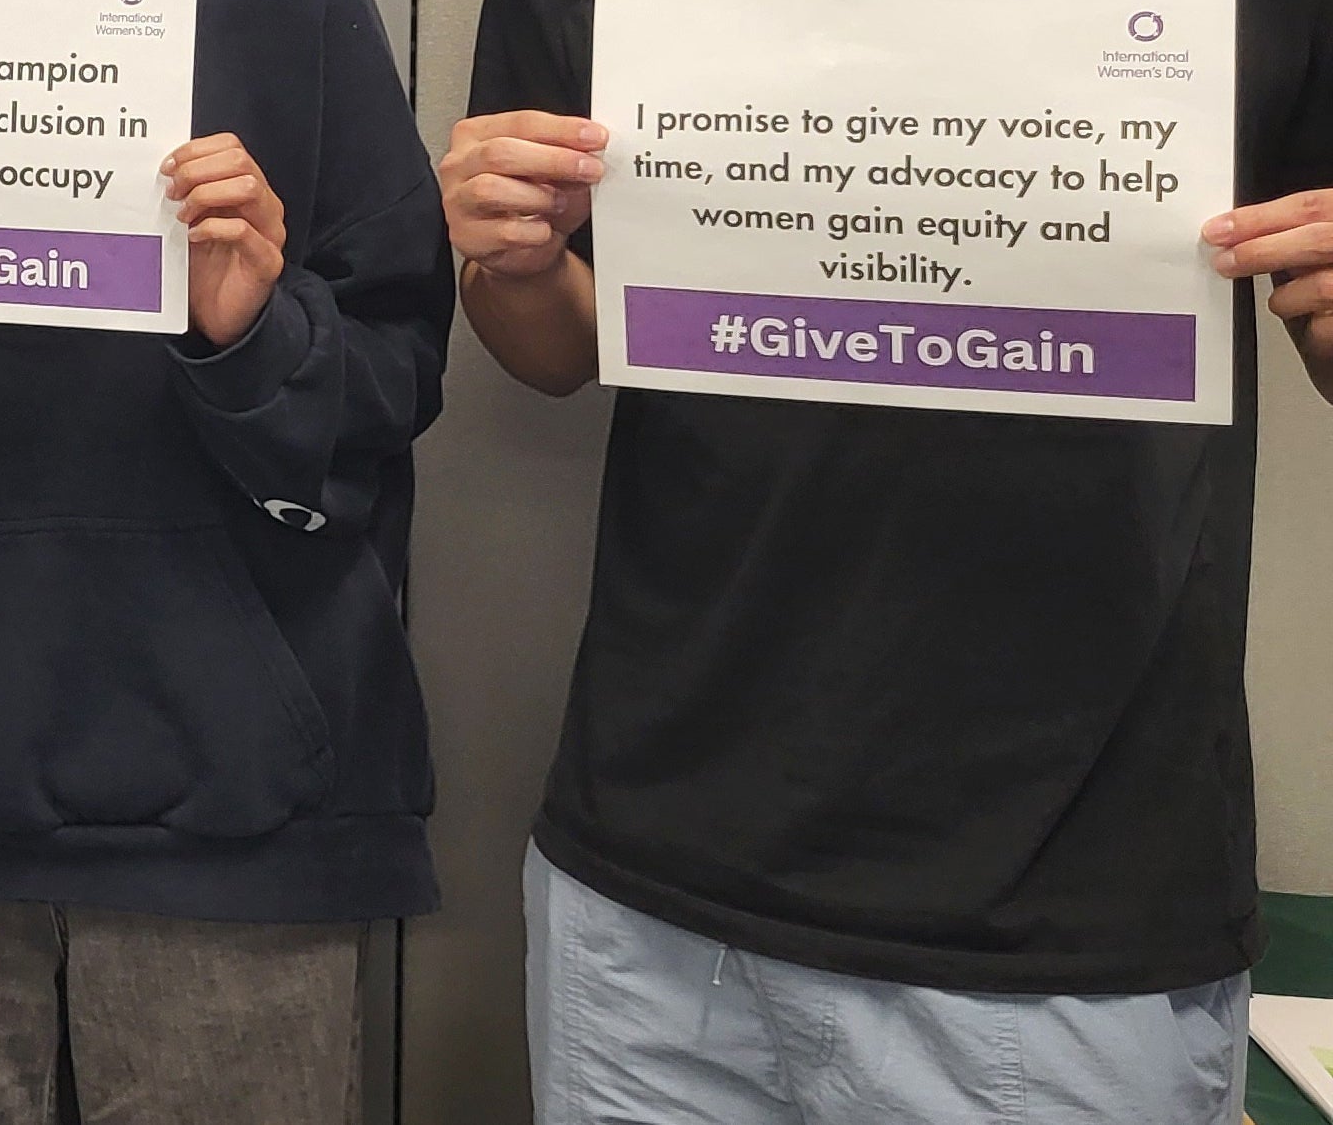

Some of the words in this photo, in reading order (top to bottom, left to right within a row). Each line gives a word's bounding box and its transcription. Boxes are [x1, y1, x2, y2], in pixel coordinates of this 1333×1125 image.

[96, 25, 142, 37] Women's
[144, 26, 166, 39] Day
[99, 12, 163, 25] International
[1097, 64, 1162, 79] Women's
[1165, 65, 1194, 82] Day
[1102, 50, 1189, 63] International
[120, 107, 147, 137] in
[638, 104, 643, 129] I
[657, 105, 789, 139] promise
[801, 110, 833, 134] to
[846, 107, 918, 143] give
[933, 118, 987, 146] my
[998, 109, 1105, 144] voice,
[1121, 121, 1177, 149] my
[0, 166, 114, 199] occupy
[634, 151, 713, 185] time,
[726, 152, 789, 182] and
[804, 165, 856, 192] my
[868, 155, 1038, 198] advocacy
[1051, 165, 1084, 190] to
[1100, 159, 1178, 202] help
[692, 209, 814, 231] women
[828, 206, 903, 240] gain
[917, 210, 1028, 248] equity
[1040, 211, 1110, 242] and
[819, 252, 971, 293] visibility.
[711, 315, 1093, 373] #GiveToGain
